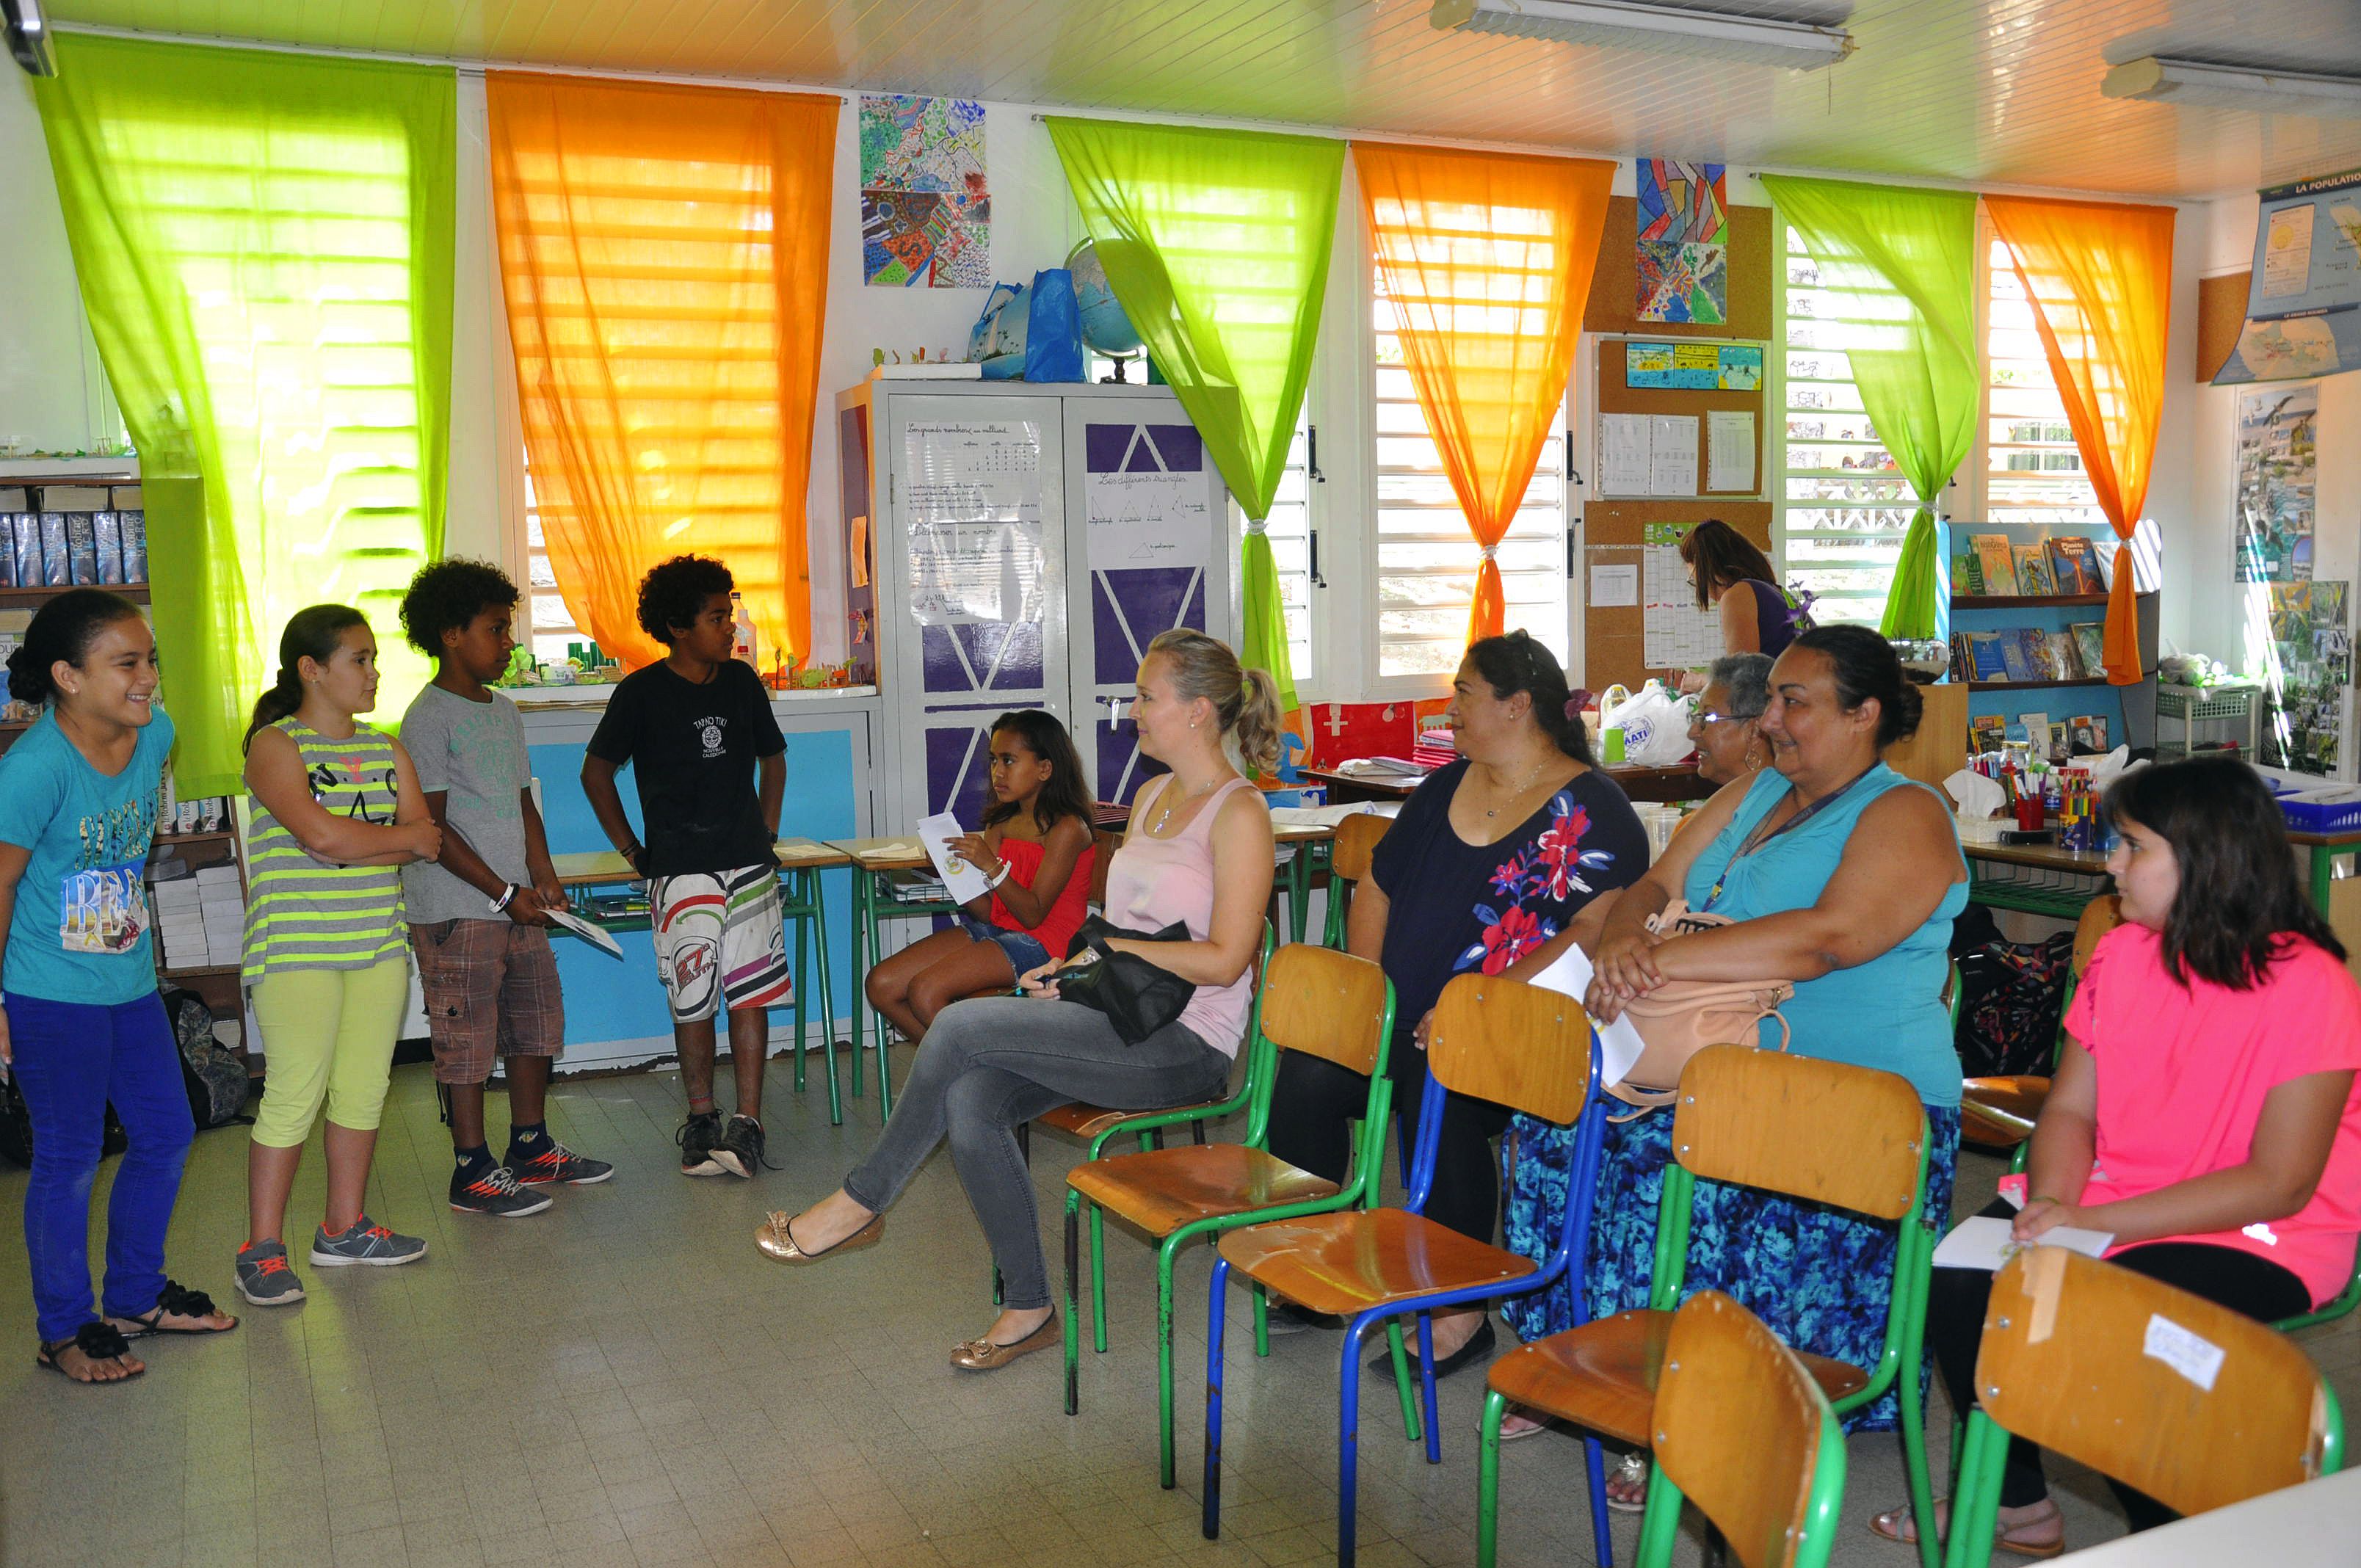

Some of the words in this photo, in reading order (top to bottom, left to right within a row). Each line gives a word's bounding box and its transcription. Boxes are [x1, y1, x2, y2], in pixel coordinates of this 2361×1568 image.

[2296, 184, 2307, 194] LA
[81, 518, 93, 559] MICRO
[135, 518, 147, 557] MICRO
[715, 716, 728, 727] TIKI
